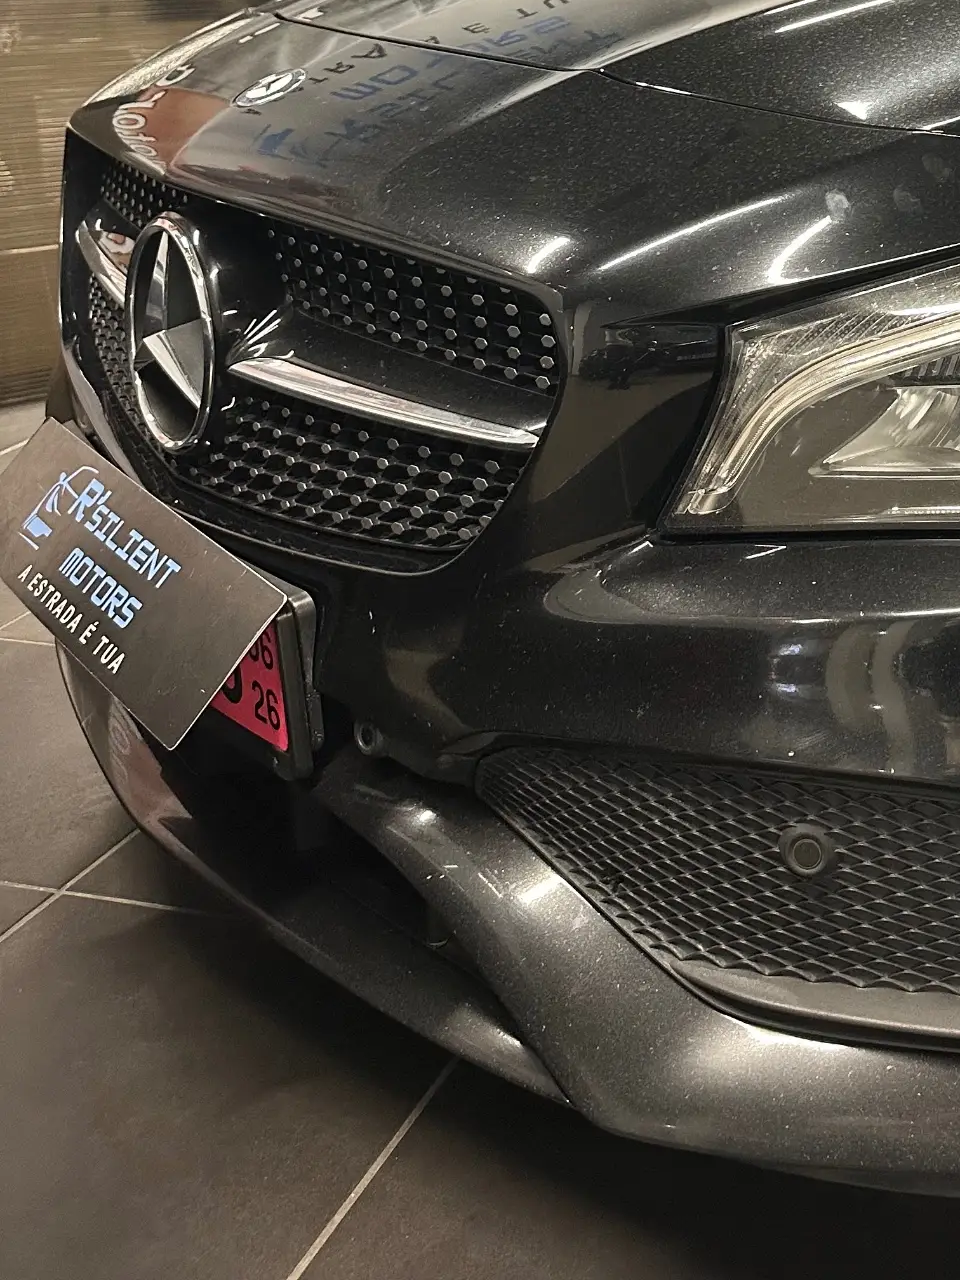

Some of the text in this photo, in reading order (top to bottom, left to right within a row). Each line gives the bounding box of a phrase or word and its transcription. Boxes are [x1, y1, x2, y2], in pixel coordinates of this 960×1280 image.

[18, 564, 126, 675] A ESTRADA É TUA
[59, 547, 143, 629] MOTORS
[252, 680, 281, 730] 26
